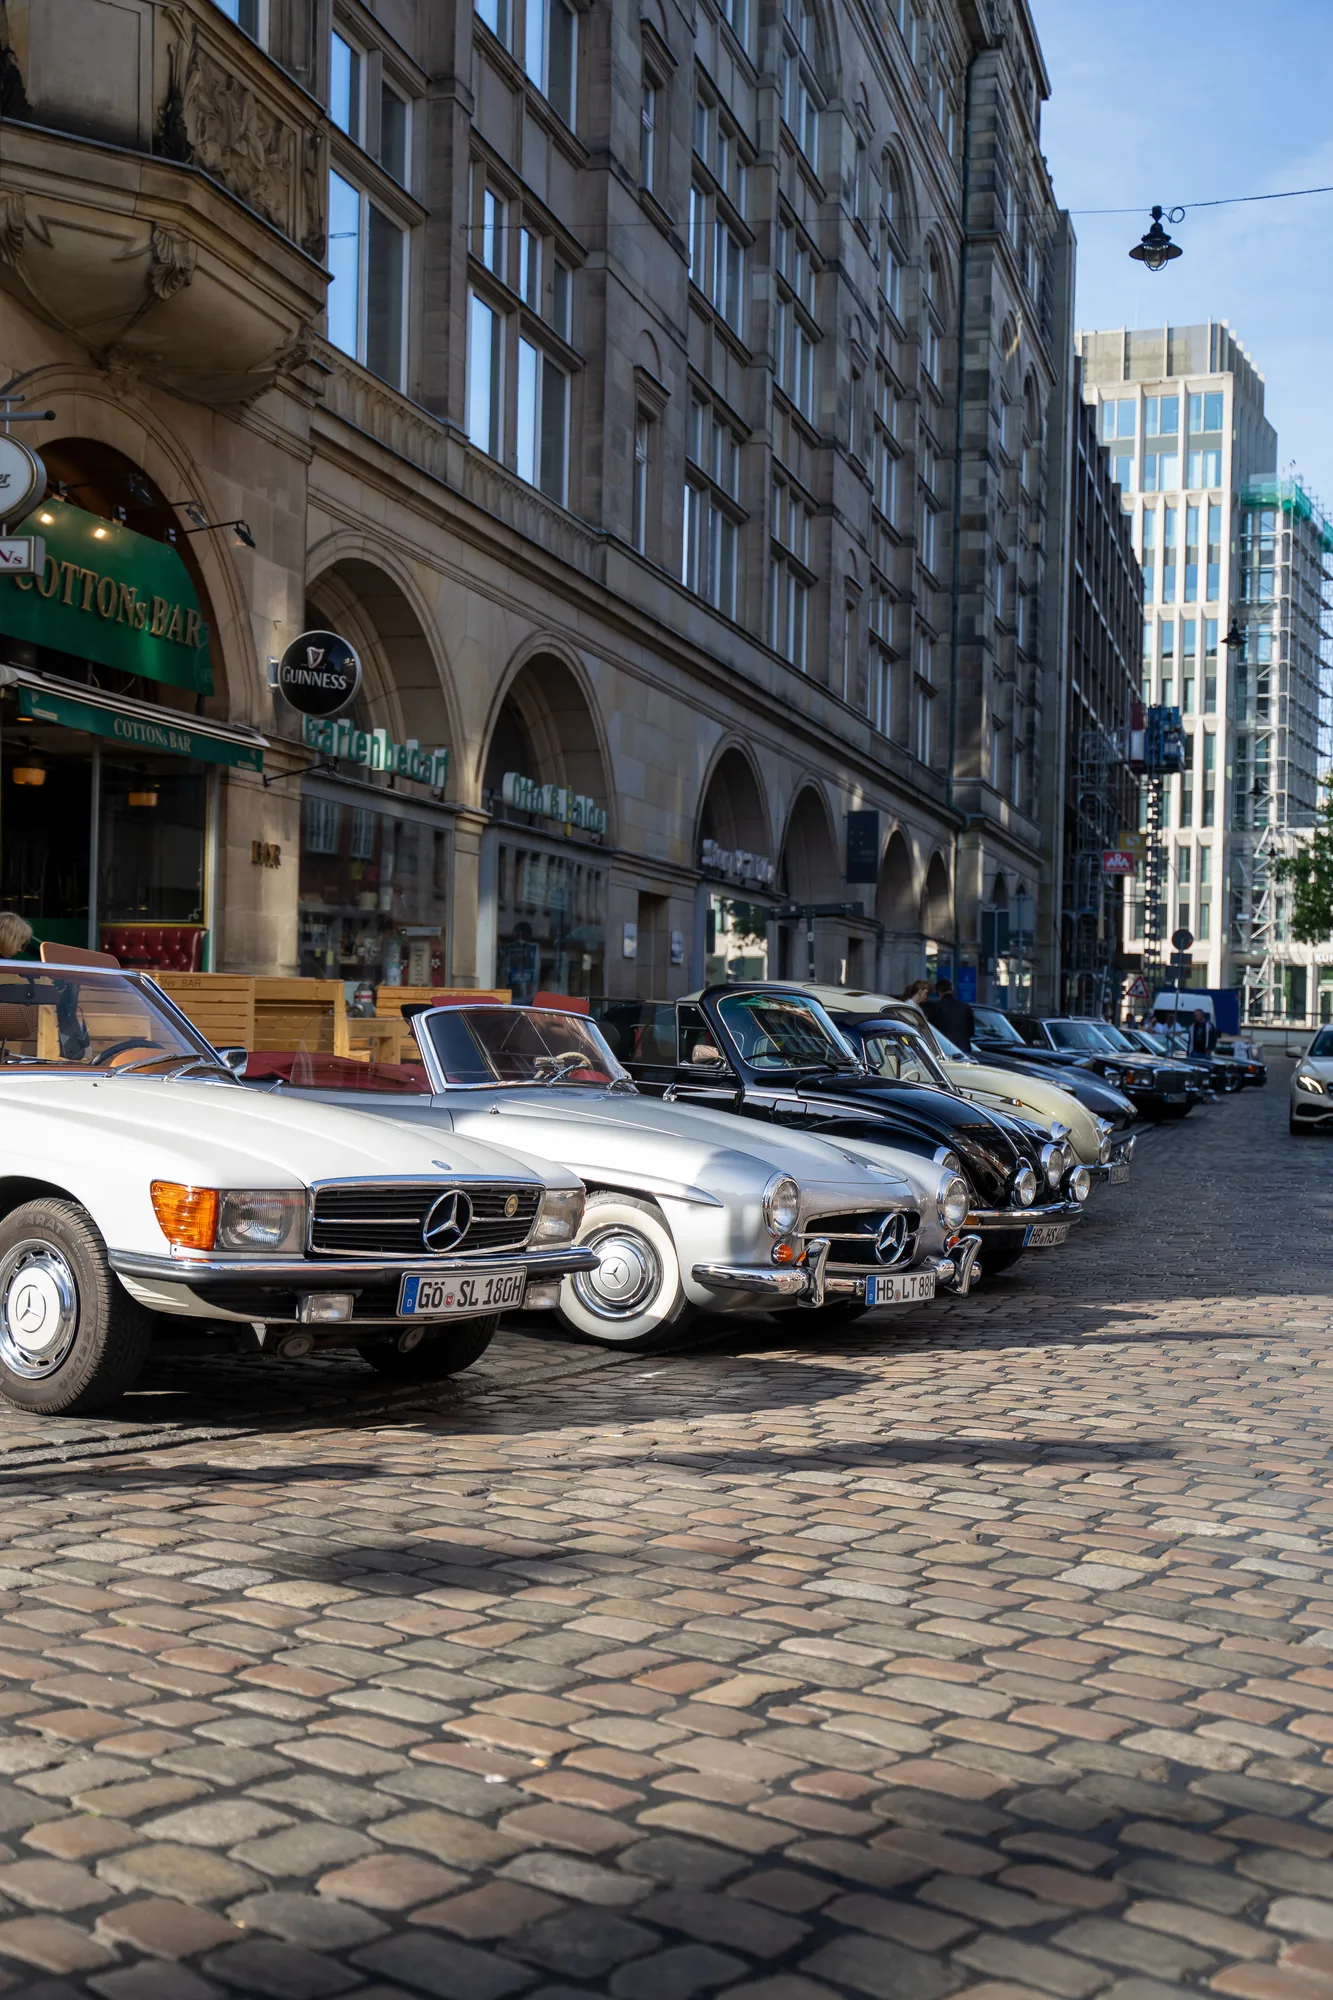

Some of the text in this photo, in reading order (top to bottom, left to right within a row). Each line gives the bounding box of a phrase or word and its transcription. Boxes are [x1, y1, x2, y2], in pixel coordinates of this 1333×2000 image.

[150, 595, 201, 648] BAR
[283, 665, 347, 690] GUINNESS
[113, 718, 192, 753] COTTONs BAR
[503, 772, 544, 815] Otto
[252, 840, 281, 869] BAR
[181, 979, 201, 988] BAR
[15, 1213, 66, 1235] CARAT
[418, 1275, 523, 1309] GÖ SL 180H
[877, 1275, 934, 1301] HB LT 88H
[406, 1299, 413, 1308] D
